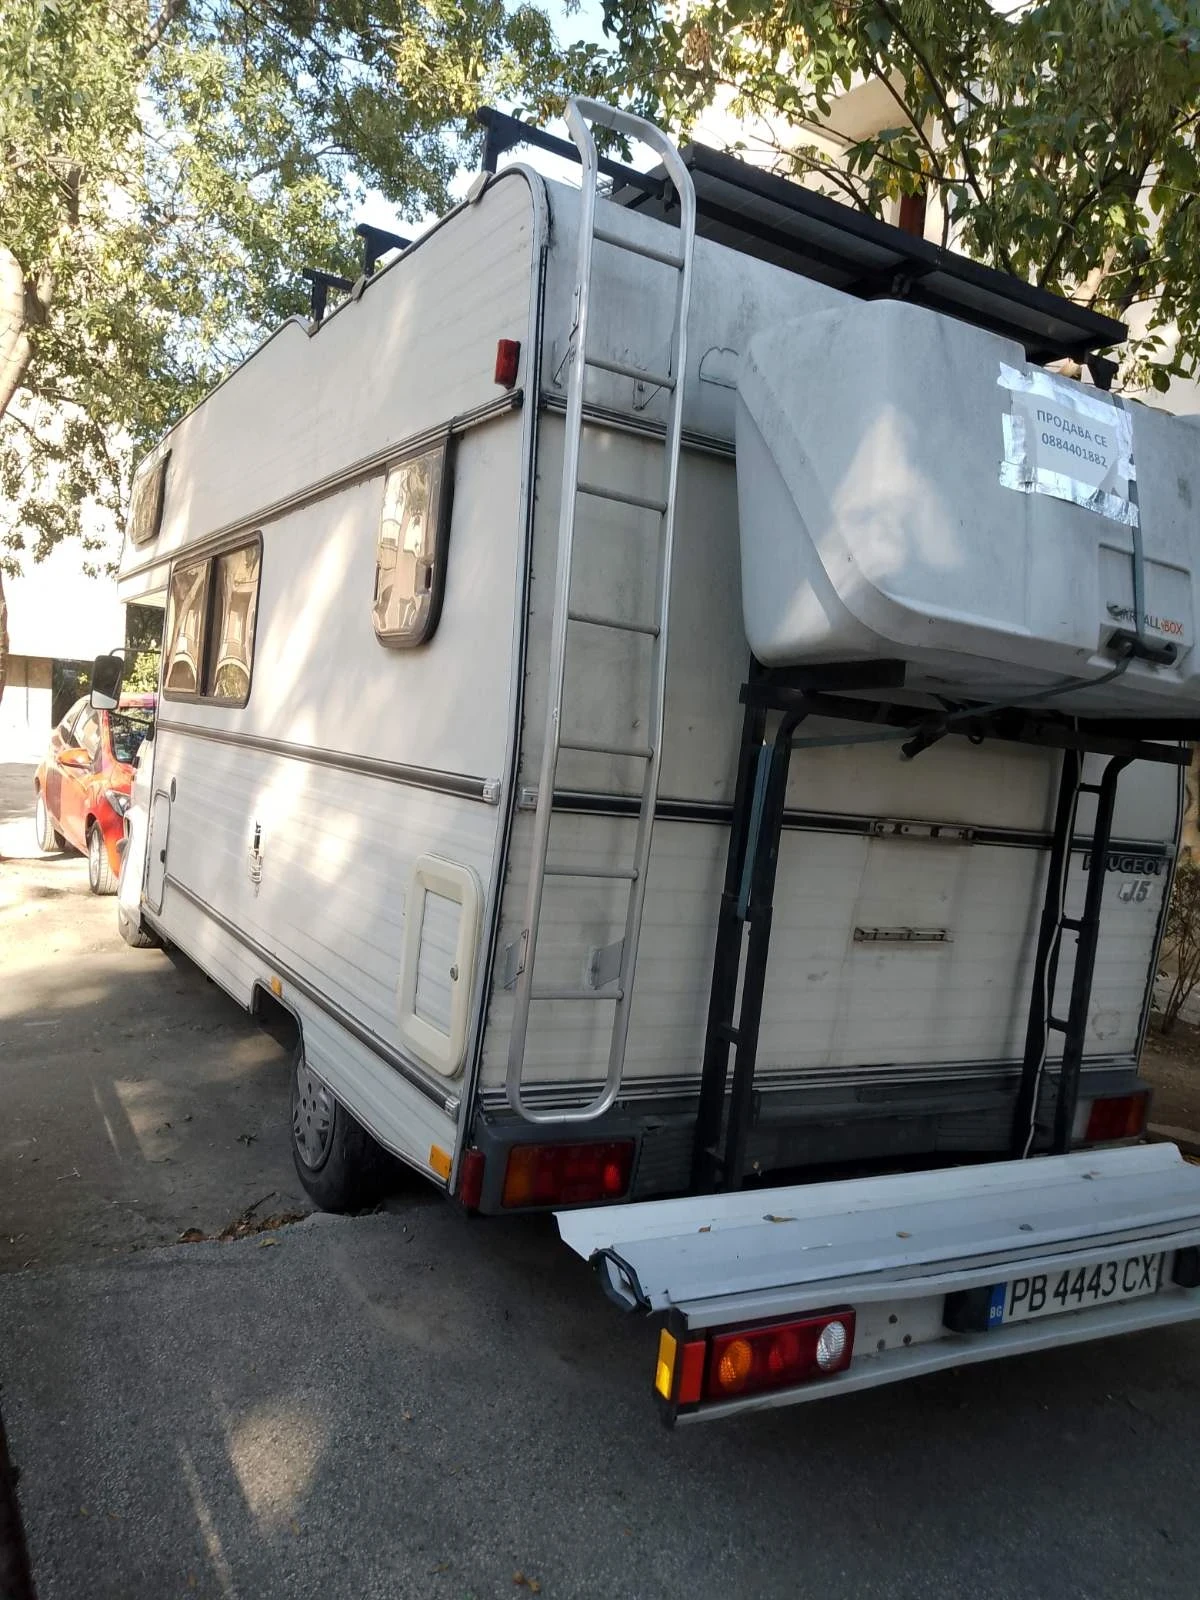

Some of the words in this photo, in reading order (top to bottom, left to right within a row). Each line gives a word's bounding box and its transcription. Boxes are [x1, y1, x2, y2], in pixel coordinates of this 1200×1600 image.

[1036, 409, 1092, 441] ПРОДАВА
[1094, 433, 1108, 448] СЕ
[1041, 432, 1108, 468] 0884401882
[1164, 618, 1183, 635] BOX
[1082, 854, 1168, 875] PUGEOT
[1008, 1274, 1048, 1316] PB
[1053, 1261, 1118, 1306] 4443
[1122, 1254, 1154, 1293] CX
[989, 1305, 1002, 1319] BG
